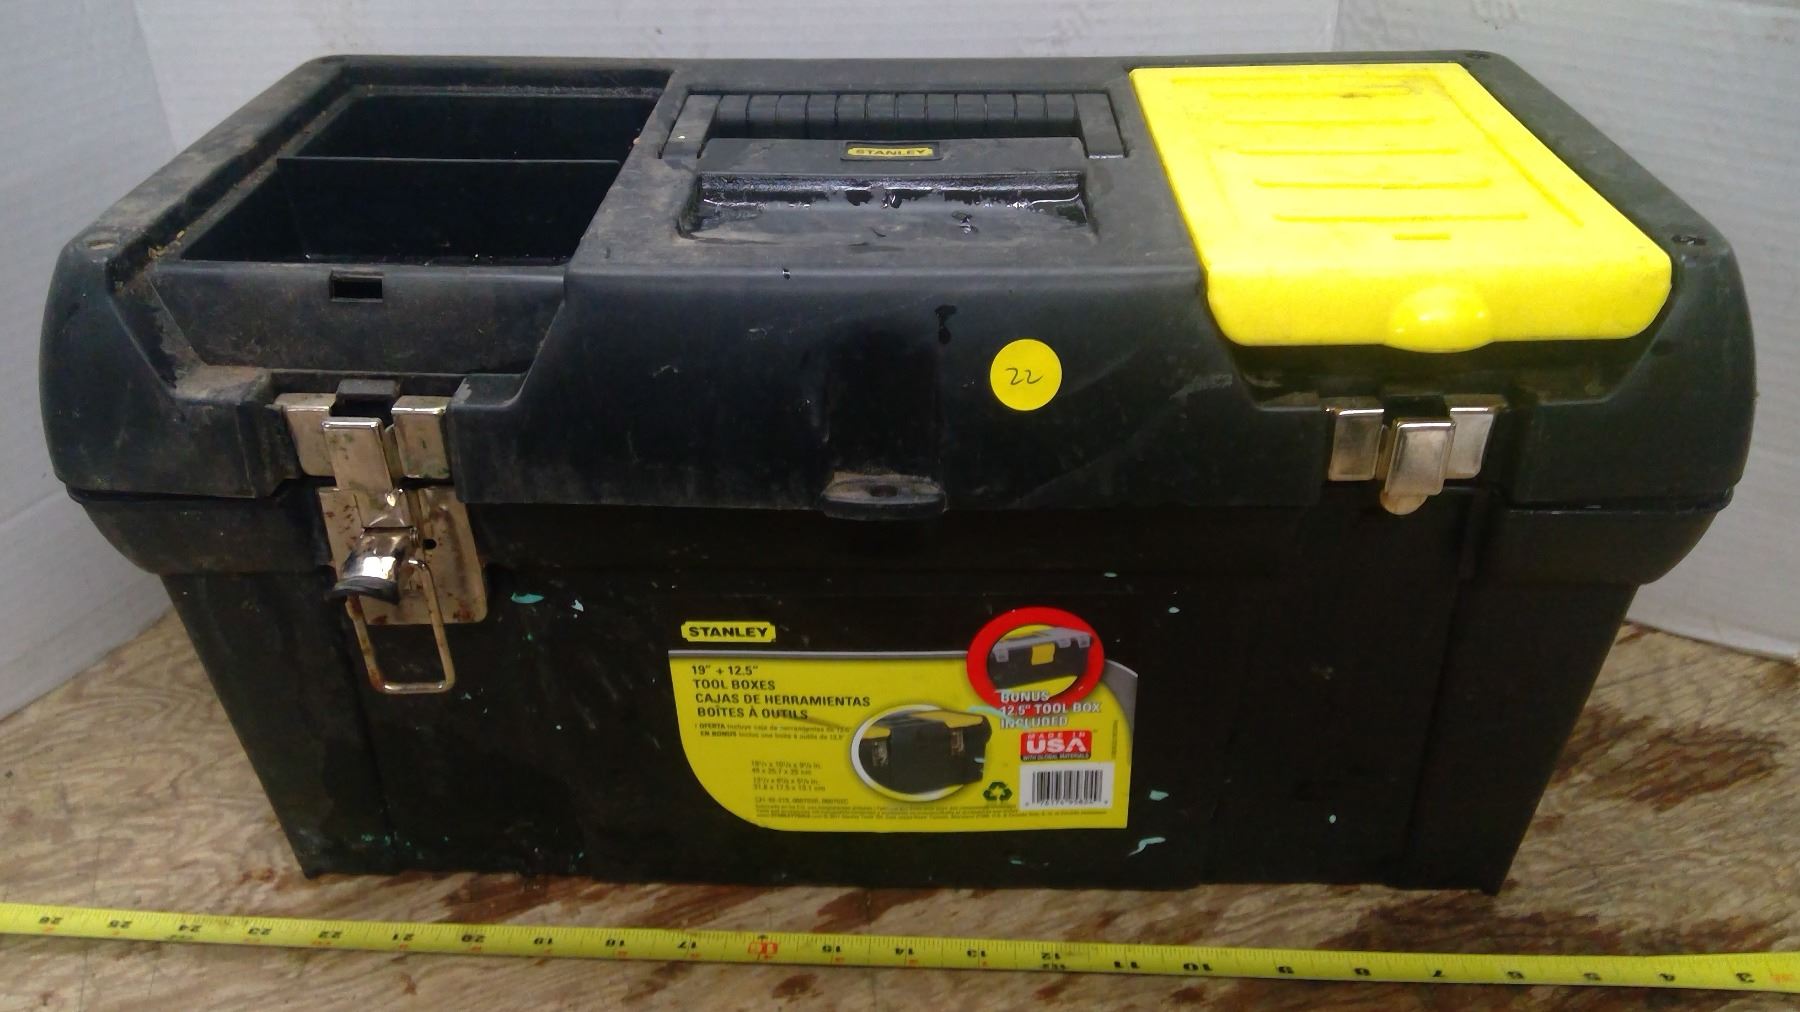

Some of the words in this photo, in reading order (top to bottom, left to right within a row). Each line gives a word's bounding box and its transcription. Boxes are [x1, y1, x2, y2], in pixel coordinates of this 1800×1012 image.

[855, 148, 926, 156] STANLEY
[1004, 367, 1044, 386] 22
[688, 626, 768, 638] STANLEY
[691, 664, 711, 676] 19"
[728, 665, 759, 676] 12.5"
[693, 679, 727, 690] TOOL
[732, 680, 775, 690] BOXES
[695, 693, 739, 704] CAJAS
[744, 694, 761, 705] DE
[765, 695, 870, 707] HERRAMIENTAS
[1001, 690, 1049, 703] BONUS
[697, 705, 744, 718] BOÎTES
[749, 705, 759, 718] À
[762, 708, 808, 720] OUTILS
[1000, 703, 1031, 716] 12.5"
[1035, 702, 1068, 715] TOOL
[1073, 702, 1101, 713] BOX
[1001, 715, 1068, 729] INCLUDED
[1026, 737, 1087, 754] USA
